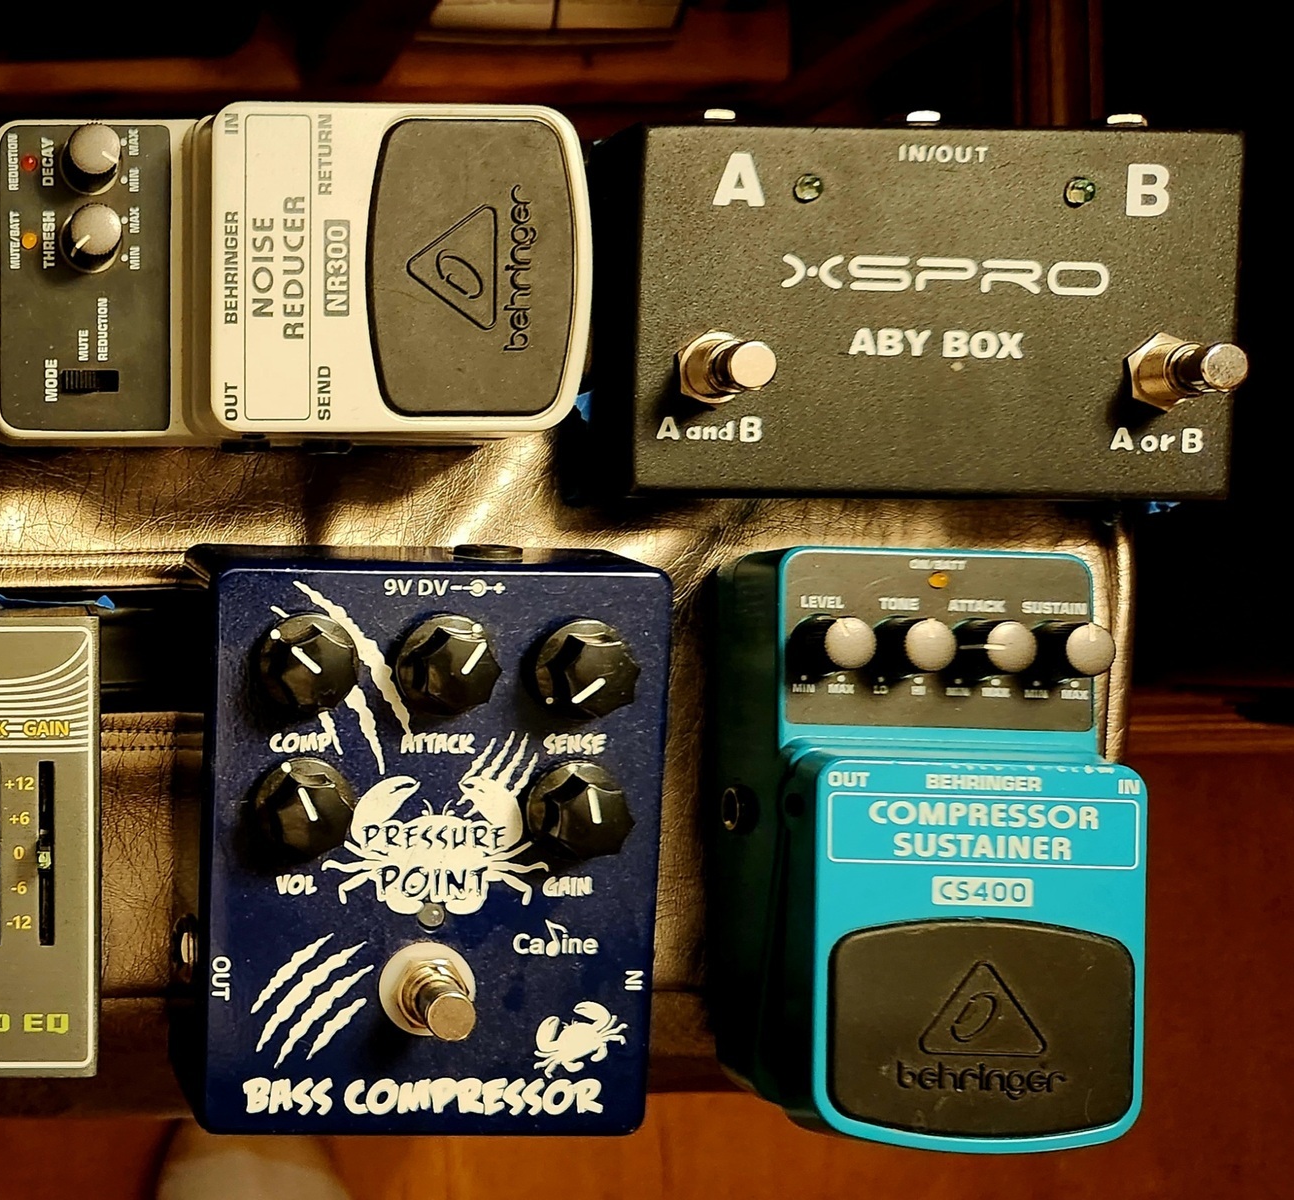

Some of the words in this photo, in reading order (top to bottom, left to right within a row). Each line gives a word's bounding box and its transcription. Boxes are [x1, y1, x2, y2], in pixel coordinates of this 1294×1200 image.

[225, 113, 239, 135] IN
[128, 128, 140, 156] MAX
[318, 113, 332, 196] RETURN
[898, 144, 988, 164] IN/OUT
[8, 133, 19, 191] REDUCTION
[41, 137, 55, 186] DECAY
[129, 167, 140, 193] MIN
[712, 151, 766, 207] A
[1125, 163, 1171, 218] B
[129, 207, 140, 234] MAX
[9, 210, 22, 270] MUTE/BATT
[42, 210, 56, 269] THRESH
[129, 245, 141, 270] MIN
[224, 210, 239, 325] BEHRINGER
[252, 216, 274, 318] NOISE
[283, 195, 306, 340] REDUCER
[324, 224, 349, 313] NR300
[503, 183, 537, 352] behringer
[781, 253, 1110, 297] XSPRO
[97, 297, 108, 362] REDUCTION
[78, 328, 89, 362] MUTE
[848, 328, 933, 358] ABY
[942, 331, 1024, 360] BOX
[45, 359, 58, 402] MODE
[317, 365, 331, 421] SEND
[224, 382, 238, 421] OUT
[656, 417, 682, 441] A
[685, 421, 736, 442] and
[739, 417, 764, 444] B
[1109, 427, 1134, 452] A
[1139, 433, 1177, 454] or
[1181, 428, 1205, 455] B
[384, 580, 412, 596] 9V
[418, 580, 449, 596] DV
[800, 595, 844, 609] LEVEL
[878, 597, 920, 611] TONE
[947, 599, 1006, 613] ATTACK
[1021, 600, 1088, 615] SUSTAIN
[792, 683, 815, 694] MIN
[827, 683, 855, 694] MAX
[1061, 688, 1089, 700] MAX
[23, 721, 69, 736] GAIN
[270, 734, 333, 754] COMP
[401, 733, 475, 755] ATTACK
[543, 733, 607, 755] SENSE
[5, 777, 34, 791] +12
[828, 770, 870, 788] OUT
[925, 773, 1043, 793] BEHRINGER
[1118, 778, 1141, 795] IN
[9, 813, 29, 826] +6
[868, 800, 1100, 830] COMPRESSOR
[363, 823, 508, 852] PRESSURE
[893, 832, 1073, 861] SUSTAINER
[14, 847, 24, 860] 0
[11, 882, 27, 895] -6
[276, 876, 317, 897] VOL
[378, 866, 489, 902] POINT
[543, 876, 594, 897] GAIN
[939, 881, 1027, 903] CS400
[7, 916, 31, 930] -12
[211, 956, 232, 1001] OUT
[624, 970, 644, 991] IN
[24, 1012, 69, 1034] EQ
[896, 1060, 1068, 1101] behringer
[242, 1077, 335, 1116] BASS
[344, 1077, 604, 1116] COMPRESSOR
